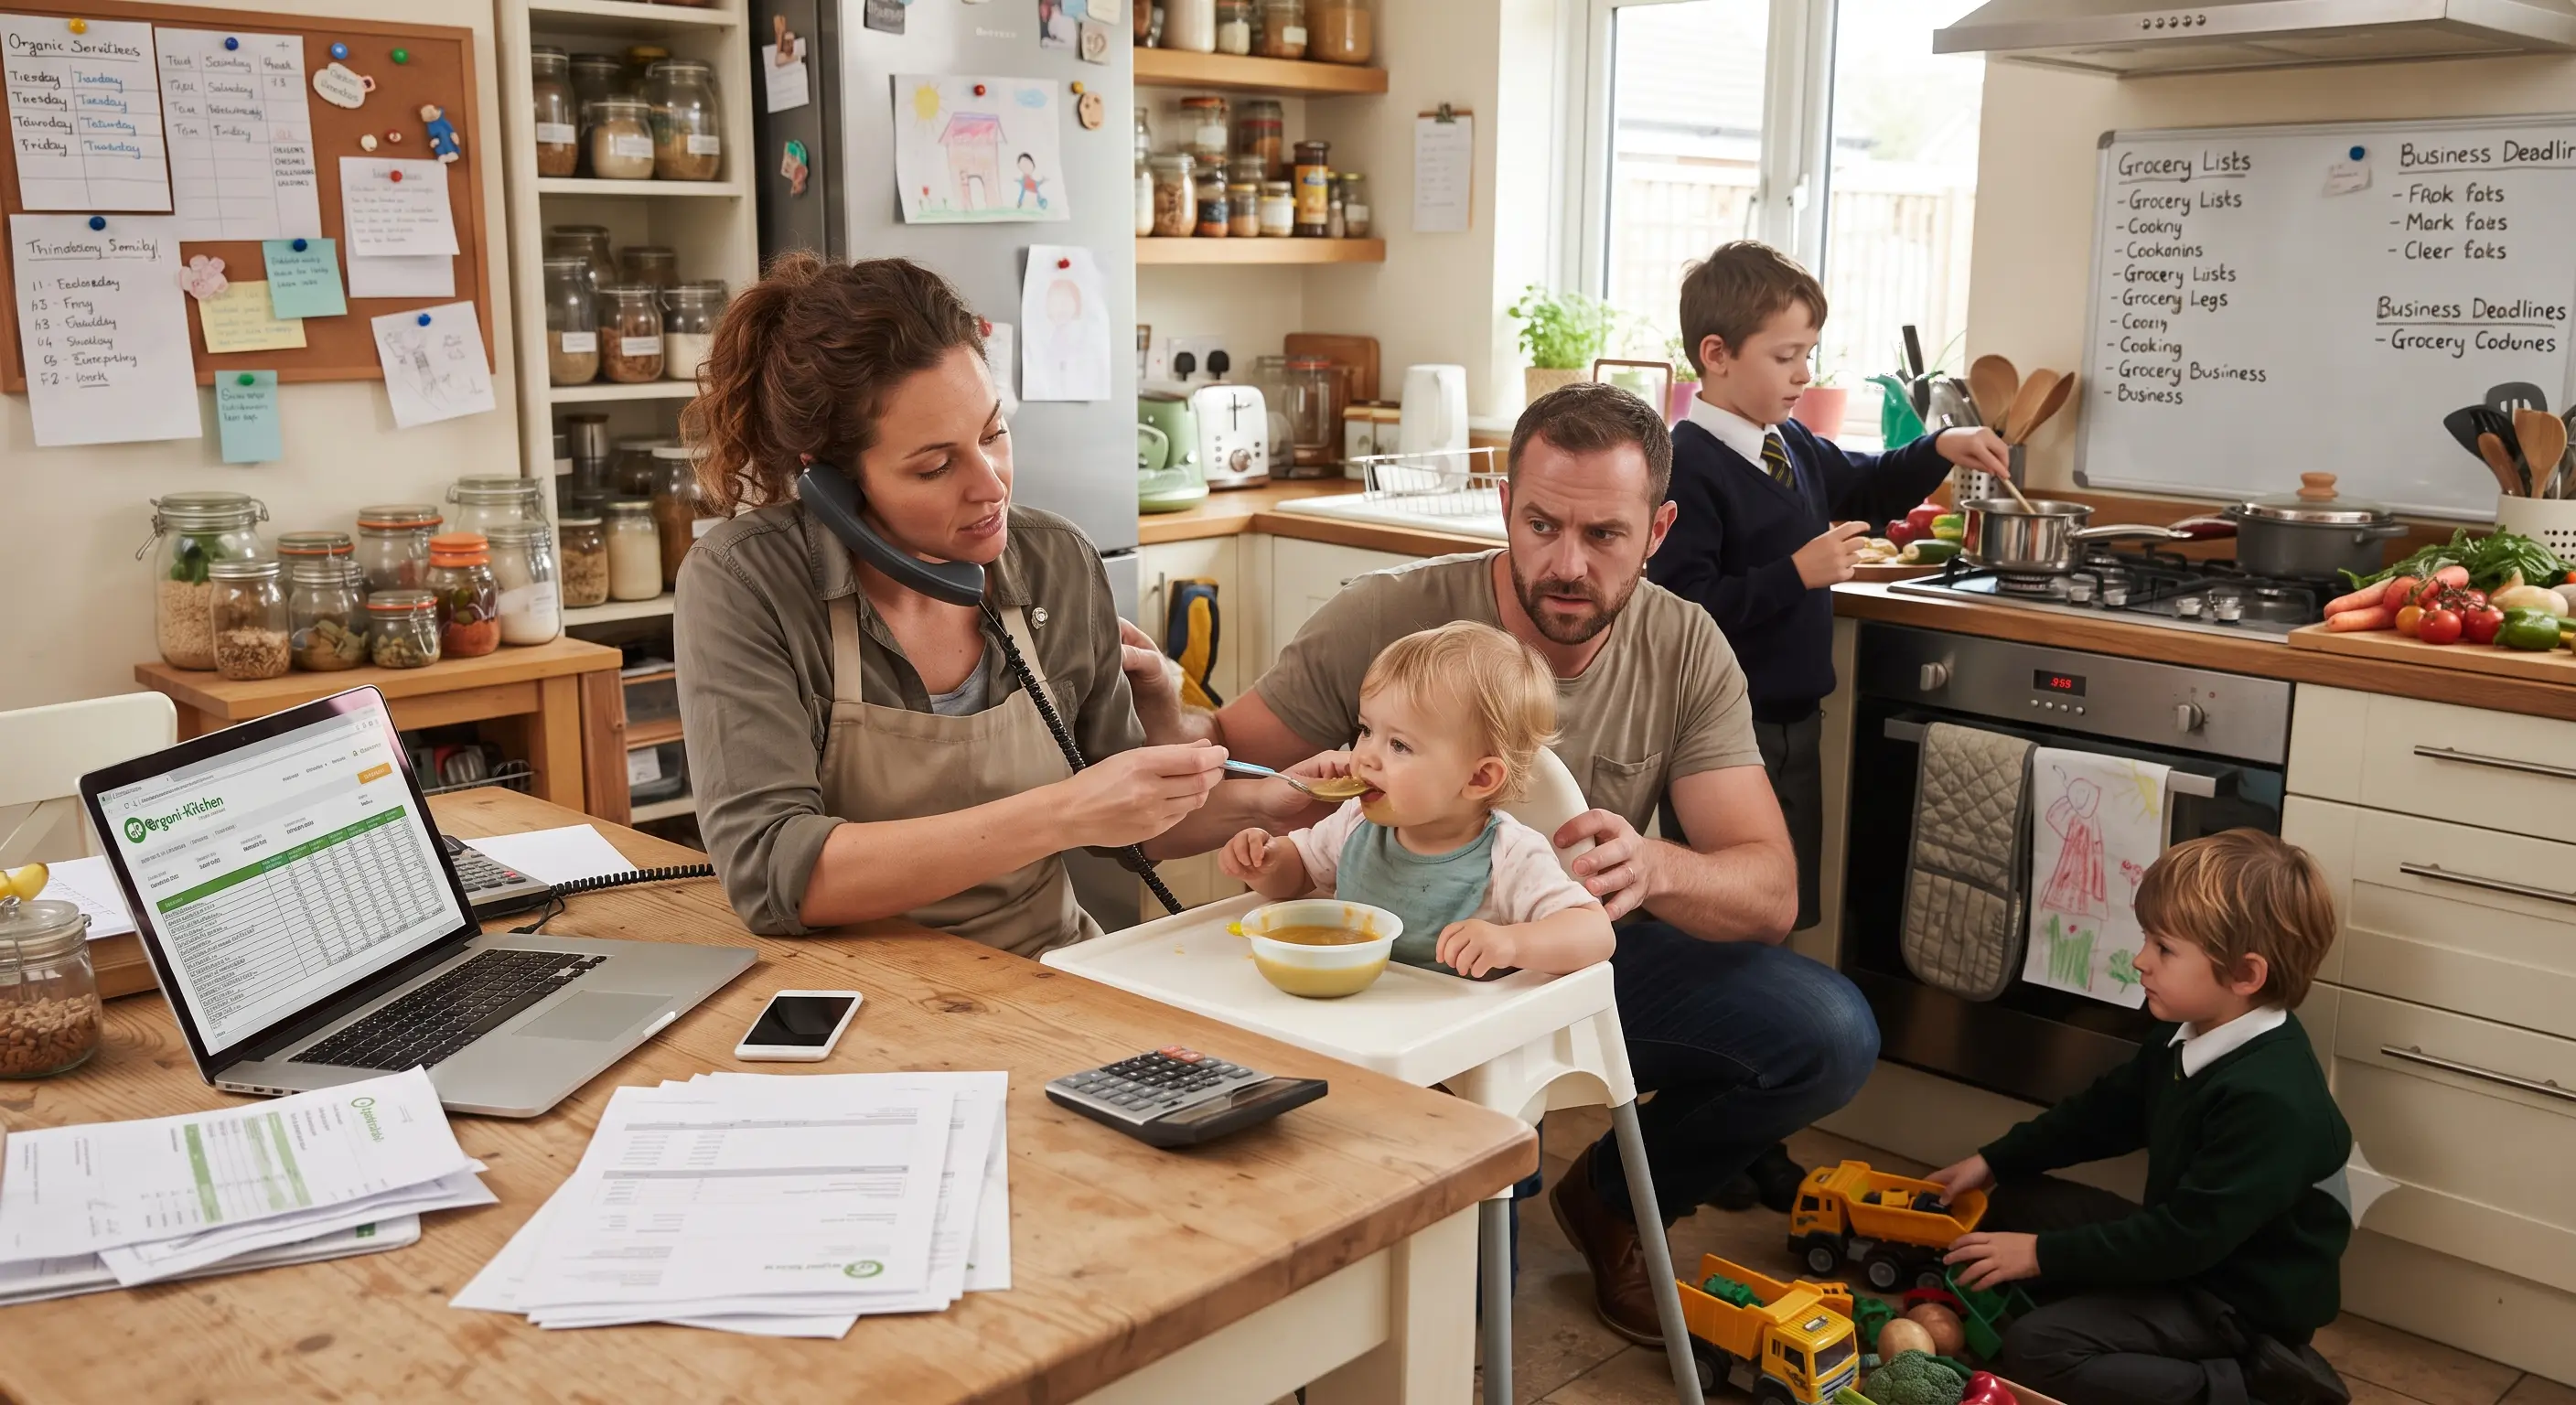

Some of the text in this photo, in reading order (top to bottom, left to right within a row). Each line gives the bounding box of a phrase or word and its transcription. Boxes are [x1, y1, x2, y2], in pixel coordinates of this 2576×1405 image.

[9, 33, 64, 58] Organic
[2119, 150, 2251, 183] Grocery Lists
[2400, 143, 2492, 167] Business
[2129, 188, 2242, 217] Grocery Lists
[2404, 240, 2454, 260] Cleer
[2124, 263, 2184, 290] Grocery
[2122, 288, 2228, 315] Grocery Legs
[2377, 295, 2567, 320] Business Deadlines
[2120, 336, 2183, 362] Cooking
[2391, 328, 2465, 359] Grocery
[2119, 359, 2183, 387] Grocery
